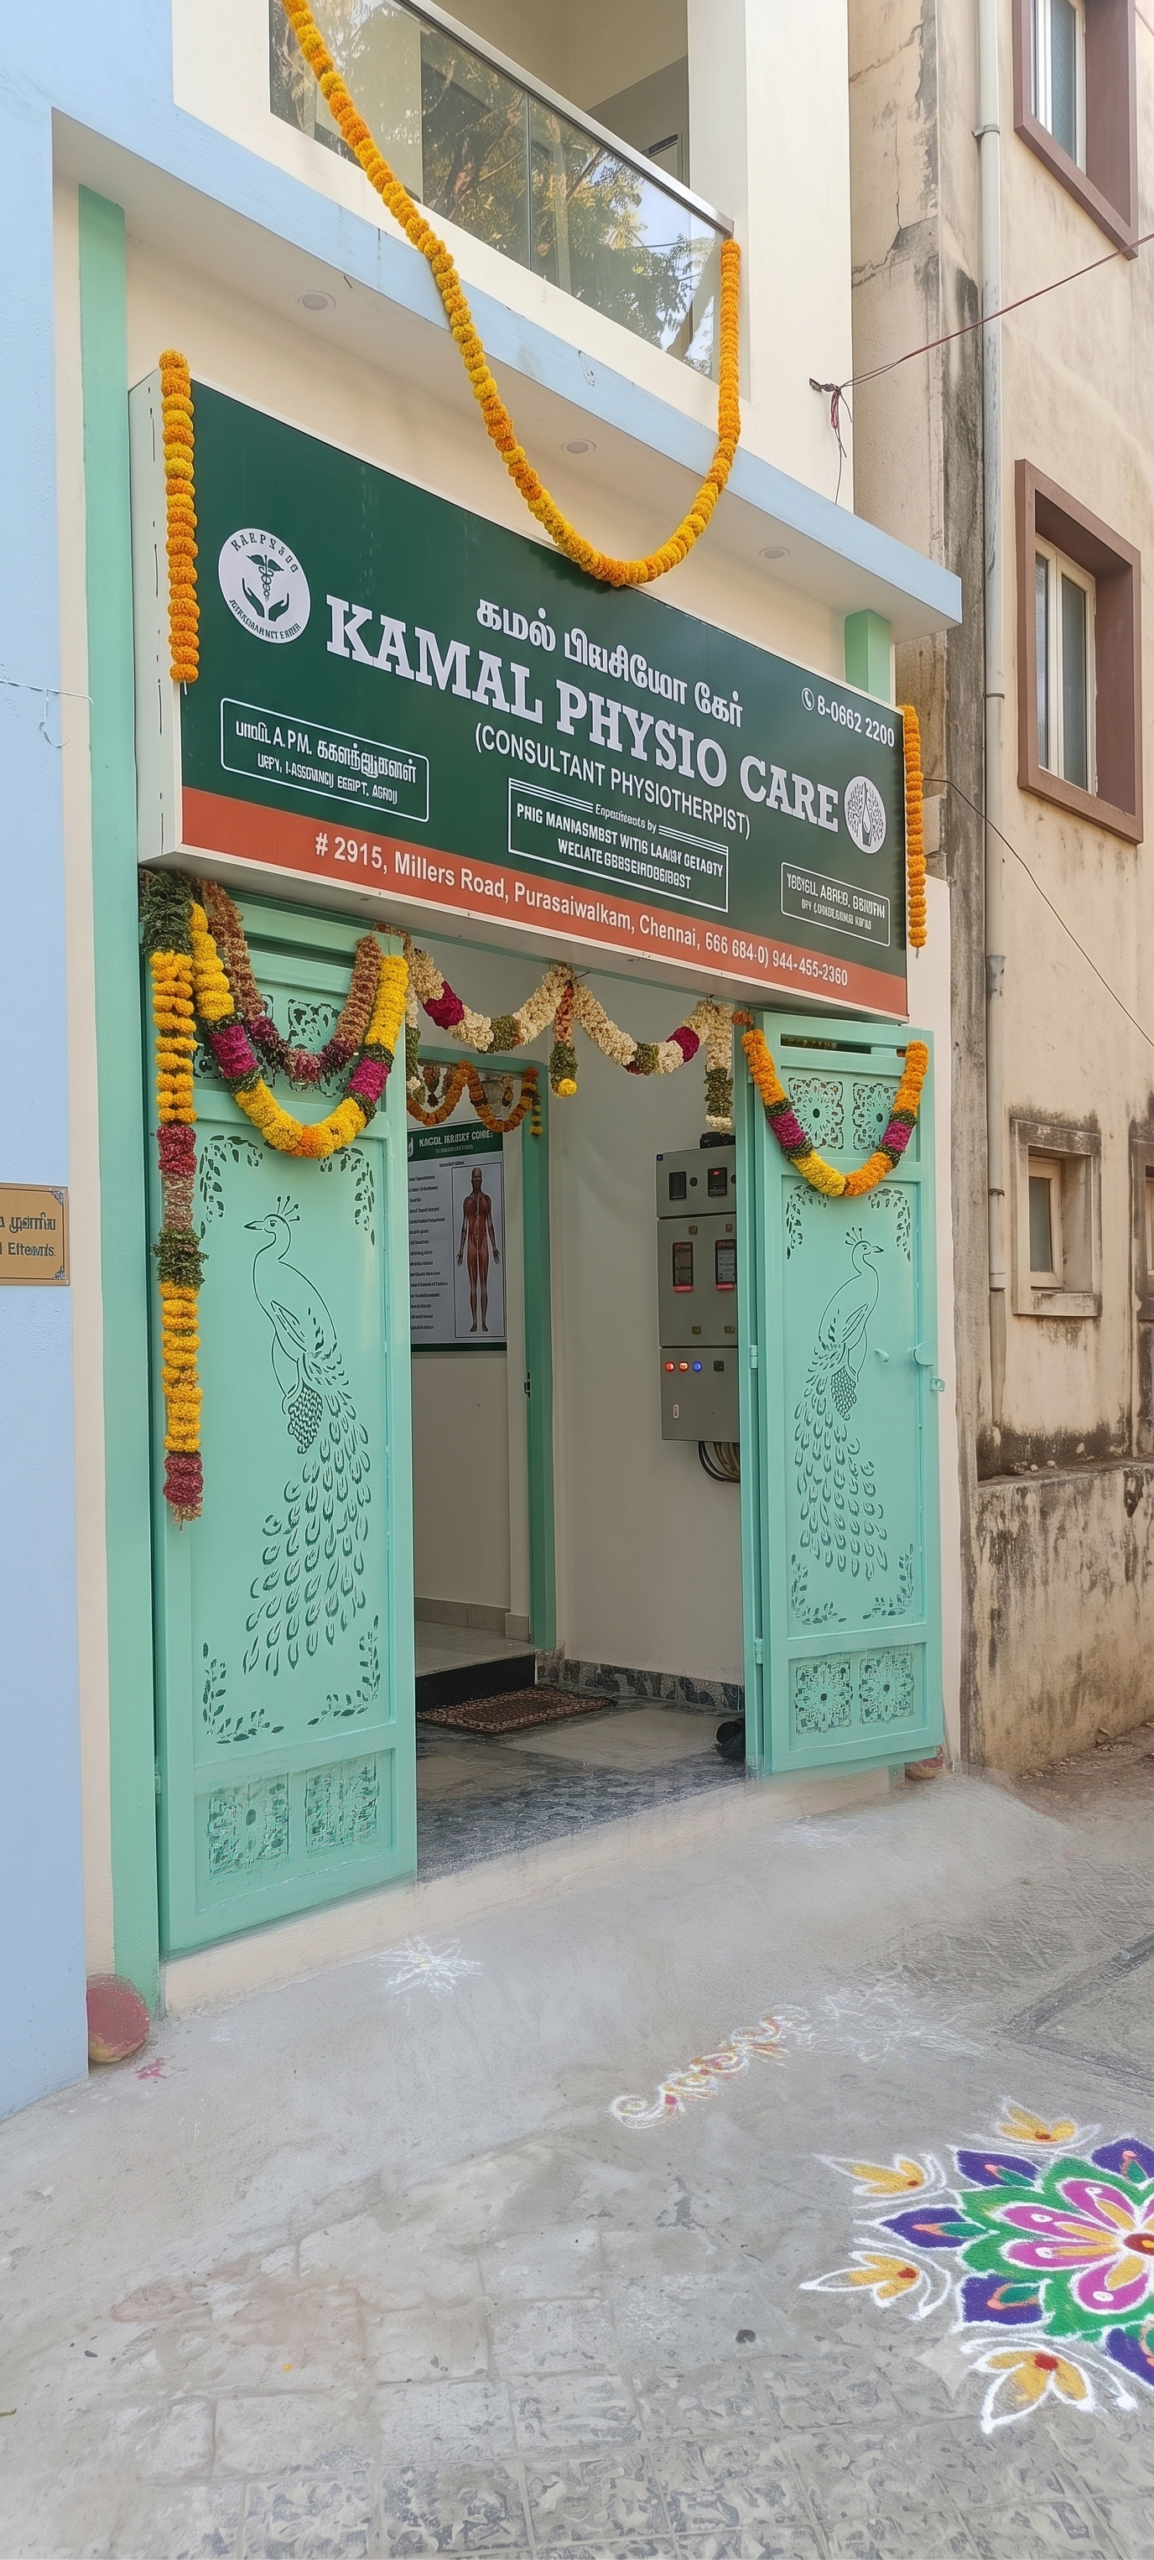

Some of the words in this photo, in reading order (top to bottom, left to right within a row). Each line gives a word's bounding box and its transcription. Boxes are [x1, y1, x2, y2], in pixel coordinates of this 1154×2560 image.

[476, 599, 556, 651] கமல்
[326, 594, 543, 724] KAMAL
[556, 679, 728, 788] PHYSIO
[740, 755, 838, 832] CARE
[865, 717, 895, 748] 2200
[475, 722, 605, 786] (CONSULTANT
[611, 767, 750, 840] PHYSIOTHERPIST)
[647, 819, 657, 834] by
[334, 836, 388, 875] 2915,
[394, 851, 455, 886] Millers
[460, 867, 509, 904] Road,
[514, 882, 635, 935] Purasaiwalkam,
[640, 914, 700, 950] Chennai,
[773, 949, 848, 987] 944-455-2360
